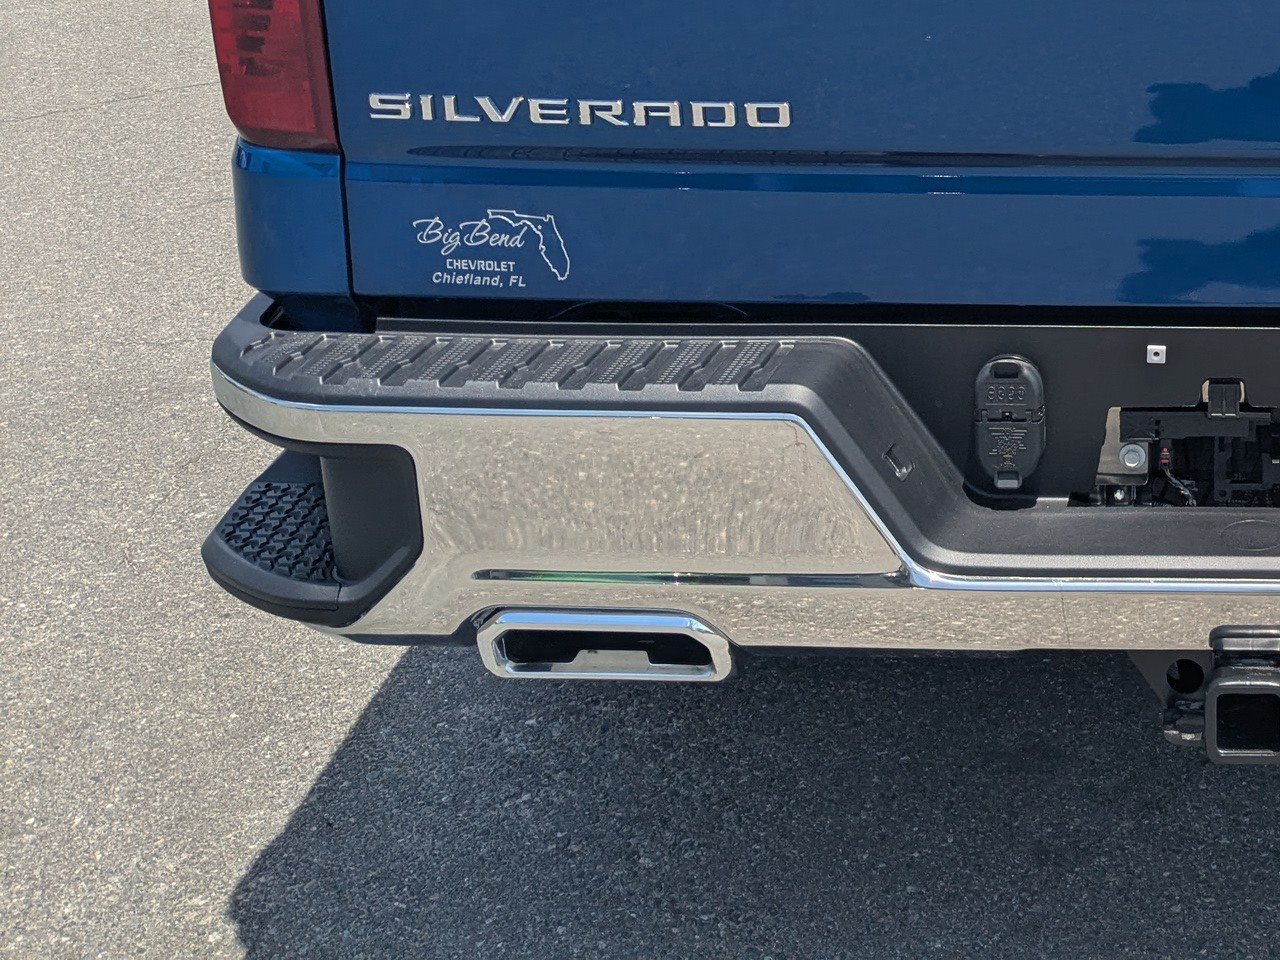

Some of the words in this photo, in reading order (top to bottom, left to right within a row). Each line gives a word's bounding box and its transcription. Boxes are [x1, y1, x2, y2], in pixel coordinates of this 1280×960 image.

[368, 93, 793, 128] SILVERADO
[412, 216, 462, 256] Big
[459, 218, 529, 248] Bend
[446, 258, 516, 272] CHEVROLET
[432, 271, 504, 288] Chiefland,
[508, 275, 527, 287] FL
